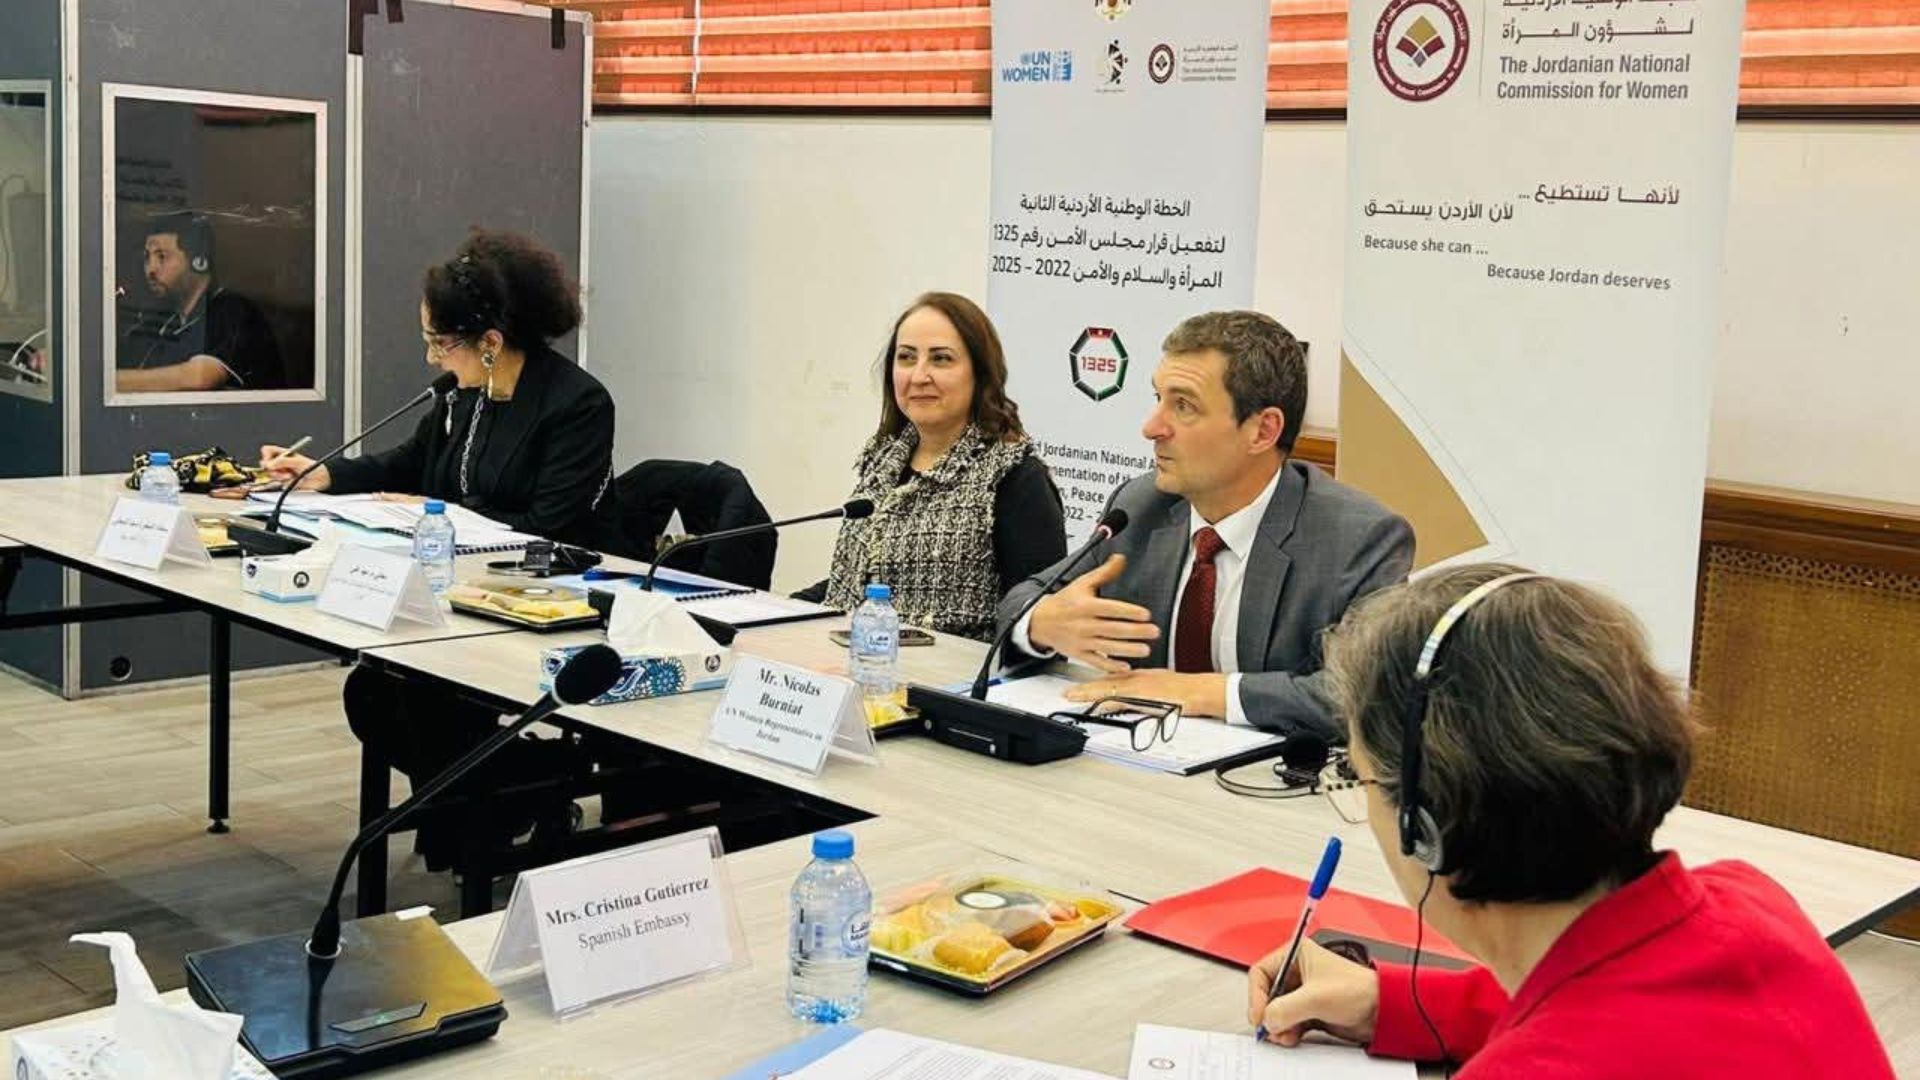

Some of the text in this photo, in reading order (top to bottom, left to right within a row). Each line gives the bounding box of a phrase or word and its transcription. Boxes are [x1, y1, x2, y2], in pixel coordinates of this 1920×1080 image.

[1502, 17, 1580, 44] المرأة
[1032, 51, 1050, 65] UN
[1500, 53, 1690, 73] The Jordanian National
[1002, 66, 1050, 82] WOMEN
[1497, 81, 1689, 99] Commission for Women
[1534, 184, 1610, 204] تستطيع
[1618, 186, 1681, 205] لأنها
[1020, 193, 1191, 220] الخطة الوطنية الأردنية الثانية
[1364, 200, 1514, 222] لأن الأردن يستحق
[993, 223, 1226, 255] لتفعيل قرار مجلس الأمن رقم 1325
[1364, 235, 1418, 252] Because
[1421, 238, 1444, 253] she
[1448, 243, 1472, 254] can
[992, 255, 1021, 274] 2025
[1035, 257, 1071, 277] 2022
[1073, 260, 1120, 287] والأمن
[1121, 264, 1176, 290] والسلام
[1178, 264, 1222, 291] المرأة
[1487, 263, 1671, 291] Because Jordan deserves
[1081, 355, 1117, 374] 1325
[1043, 443, 1097, 461] Jordanian
[1101, 450, 1146, 469] National
[1108, 471, 1121, 485] of
[1071, 486, 1105, 503] Peace
[757, 668, 821, 697] Mr. Nicolas
[759, 692, 804, 716] Burniat
[545, 877, 710, 925] Mrs. Cristina Gutierrez
[578, 912, 692, 950] Spanish Embassy
